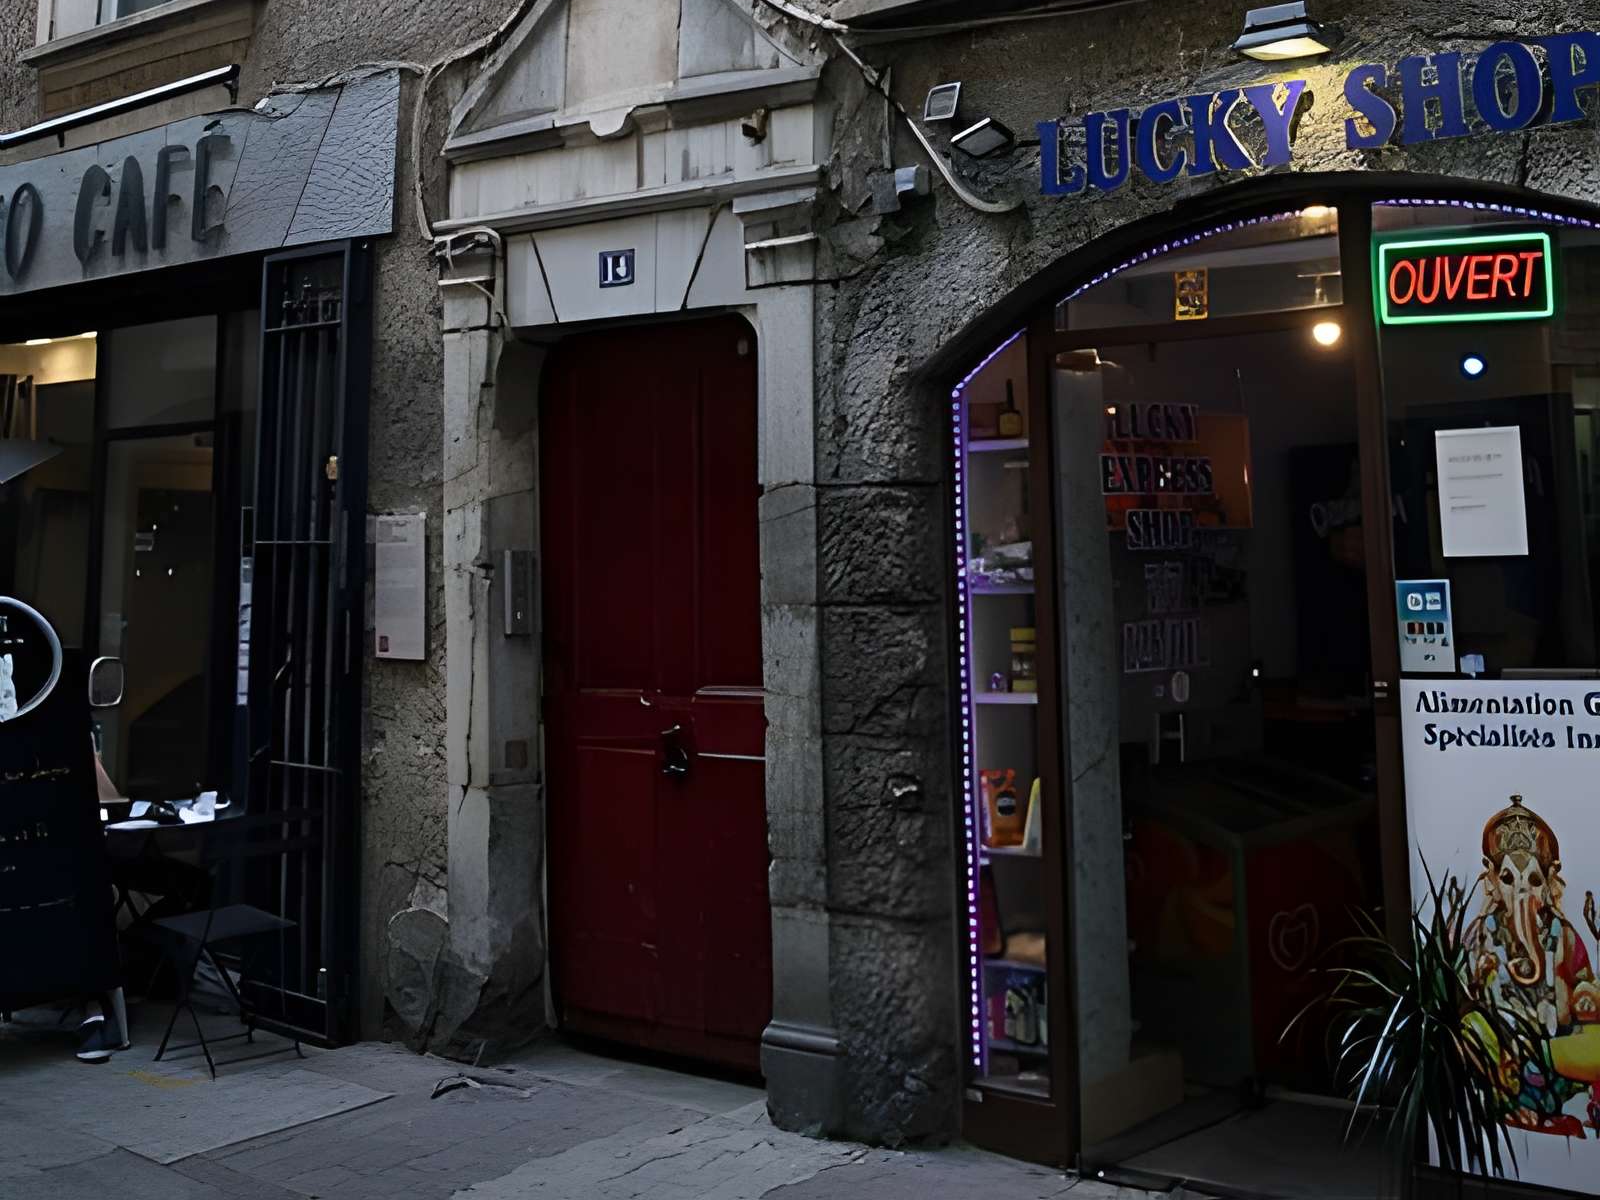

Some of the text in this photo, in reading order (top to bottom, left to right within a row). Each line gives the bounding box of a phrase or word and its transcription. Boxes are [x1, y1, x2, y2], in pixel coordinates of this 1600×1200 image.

[1036, 31, 1600, 195] LUCKY SHOP
[1389, 251, 1543, 305] OUVERT
